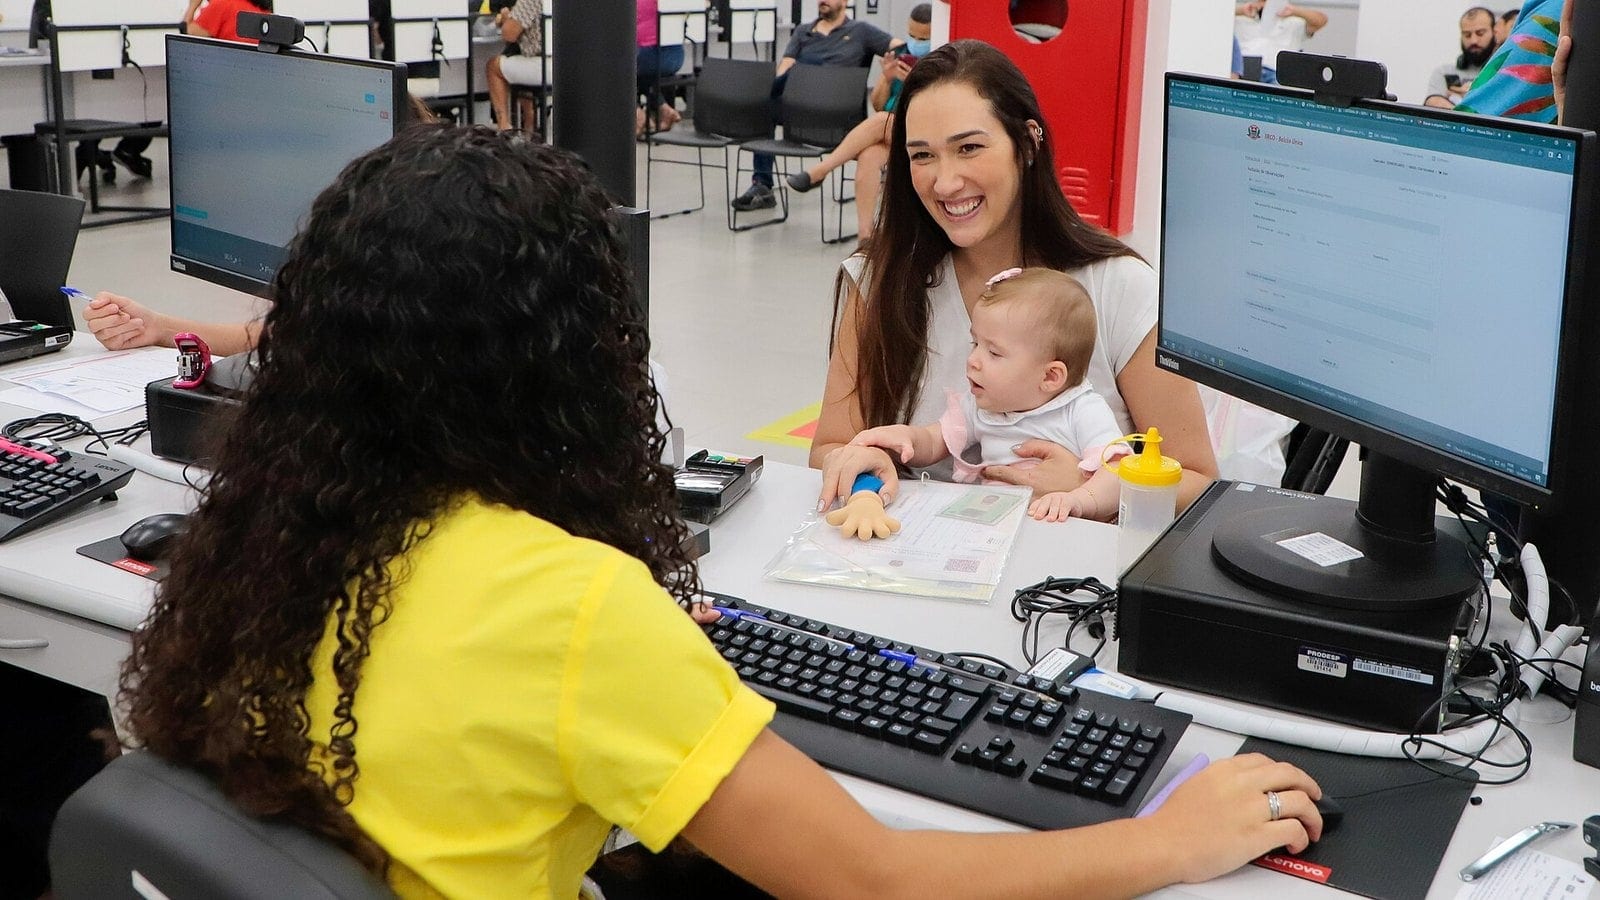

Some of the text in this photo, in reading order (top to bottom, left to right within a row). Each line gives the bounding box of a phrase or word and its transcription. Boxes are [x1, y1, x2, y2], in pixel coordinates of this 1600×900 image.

[94, 463, 120, 472] Lenovo
[1307, 649, 1340, 660] PRODESP
[1264, 855, 1324, 876] Lenovo
